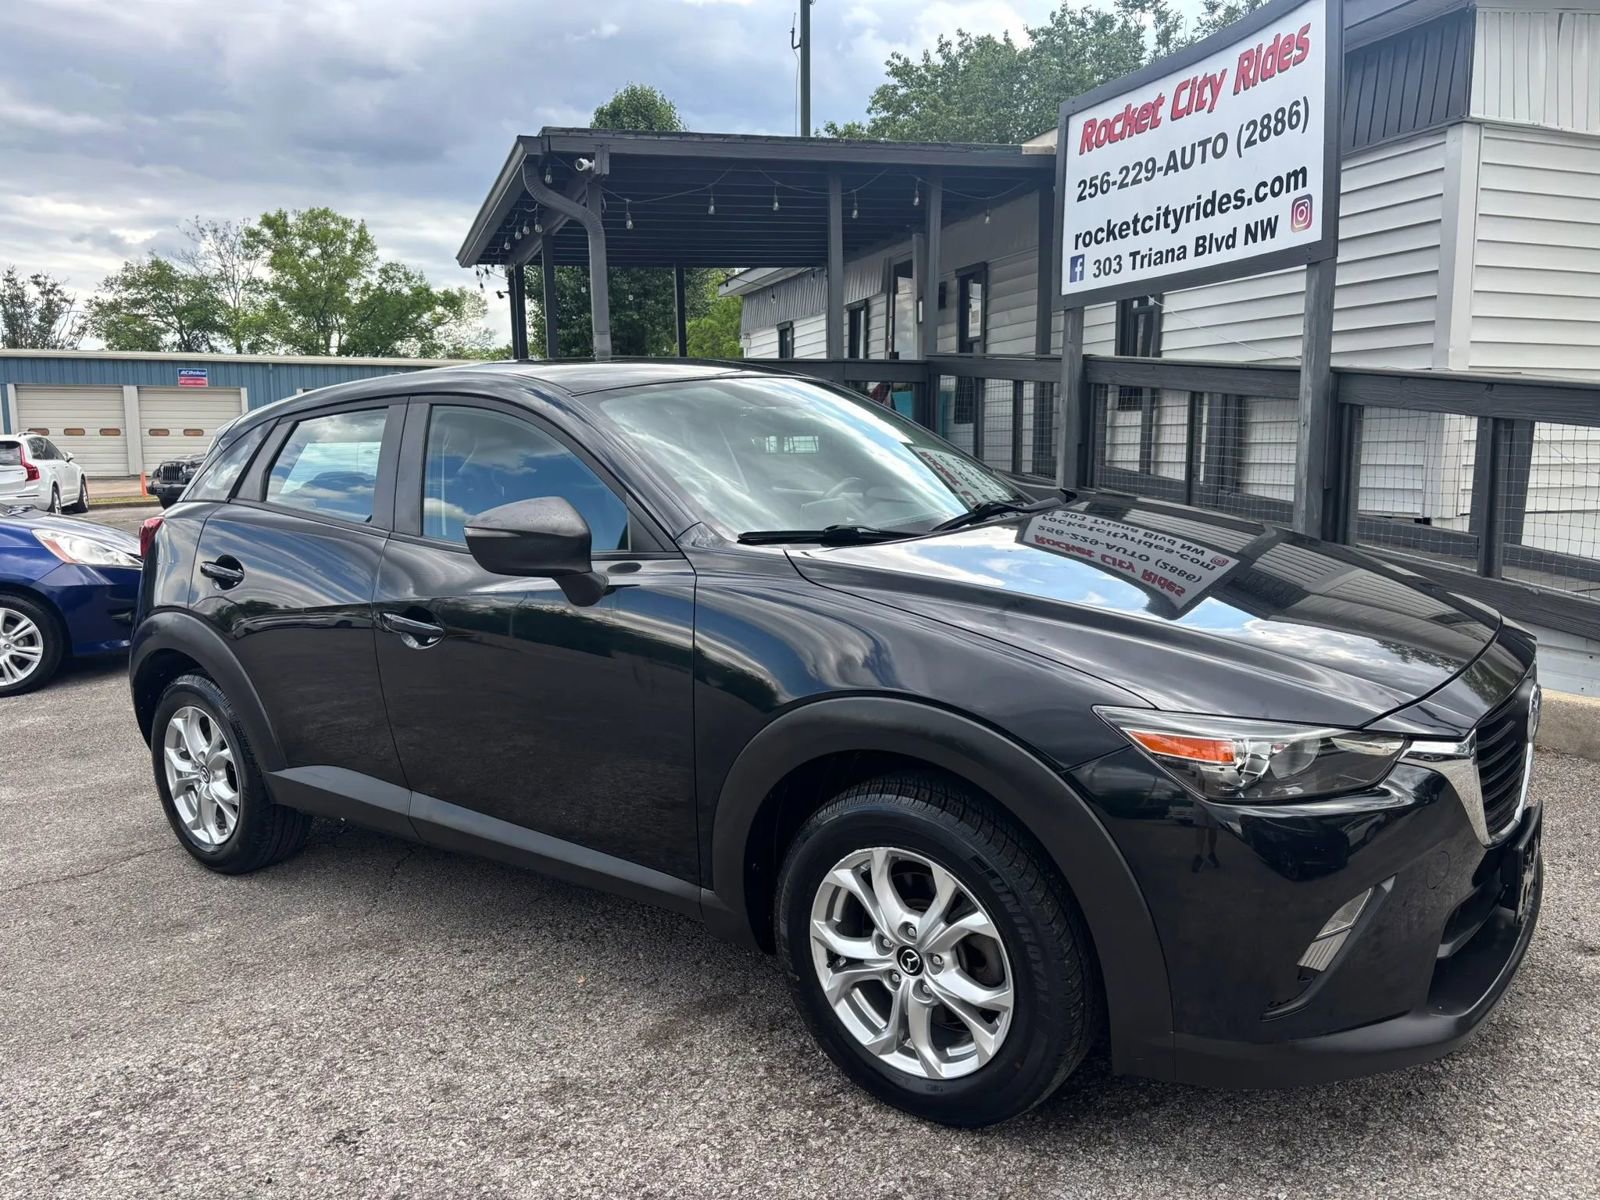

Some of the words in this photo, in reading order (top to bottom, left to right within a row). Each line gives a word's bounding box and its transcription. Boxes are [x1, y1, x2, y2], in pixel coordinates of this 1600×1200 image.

[1079, 92, 1165, 155] Rocket
[1170, 68, 1228, 122] City
[1233, 23, 1312, 96] Rides
[1076, 132, 1229, 202] 256-229-AUTO
[1236, 96, 1310, 158] (2886)
[1074, 166, 1308, 250] rocketcityrides.com
[1092, 254, 1123, 279] 303
[1129, 244, 1187, 271] Triana
[1194, 228, 1237, 257] Blvd
[1243, 215, 1280, 246] NW
